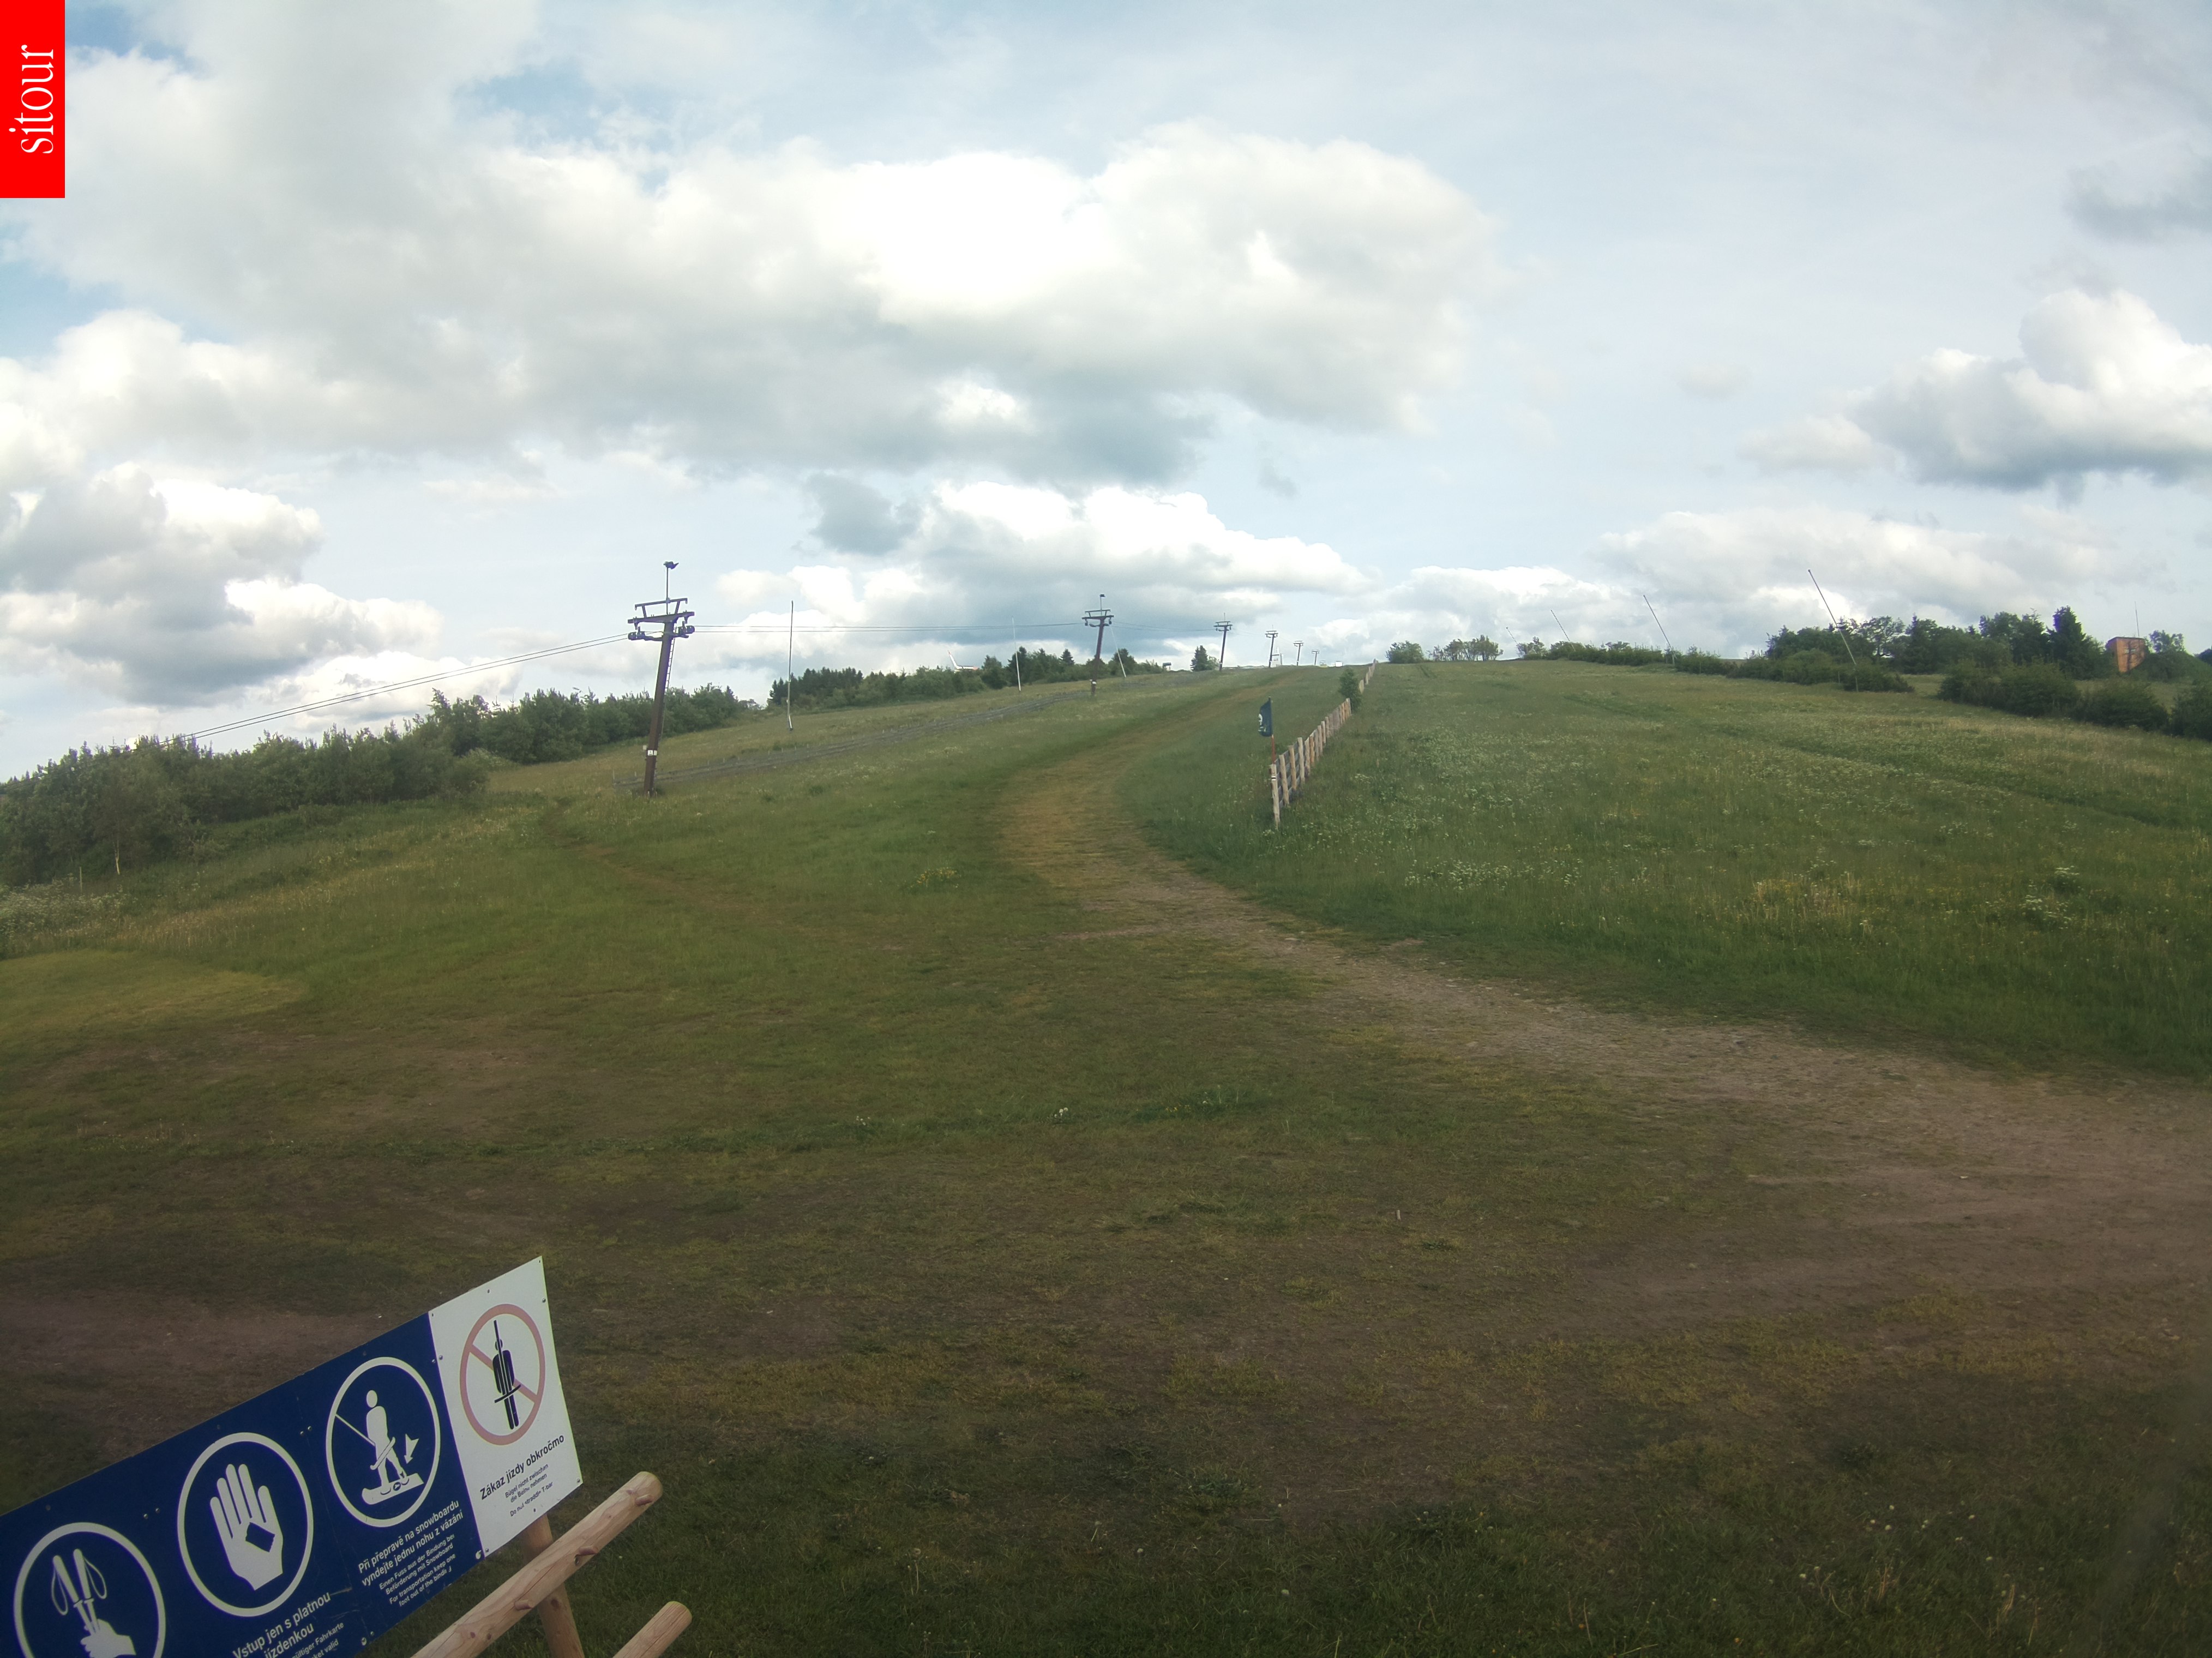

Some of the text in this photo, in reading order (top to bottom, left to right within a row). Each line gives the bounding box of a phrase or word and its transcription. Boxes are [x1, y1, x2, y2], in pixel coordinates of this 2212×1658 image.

[480, 1435, 564, 1500] Zákaz jízdy obkročmo
[518, 1477, 529, 1489] nicht
[529, 1464, 549, 1481] zwischen
[358, 1500, 459, 1573] Při přepravě na snowboardu
[362, 1509, 464, 1586] vyndejte jednu nohu z vázání
[379, 1577, 395, 1590] Einen
[394, 1567, 407, 1579] Fuss
[407, 1560, 417, 1570] aus
[417, 1554, 426, 1564] der
[426, 1540, 447, 1557] Bindung
[386, 1543, 454, 1595] Beförderung mit Snowboard
[389, 1554, 456, 1605] For transportation keep one
[410, 1589, 419, 1599] out
[425, 1579, 434, 1588] the
[232, 1592, 331, 1658] Vstup jen s platnou
[292, 1623, 344, 1658] ültiger Fahrkarte
[324, 1638, 339, 1653] valid
